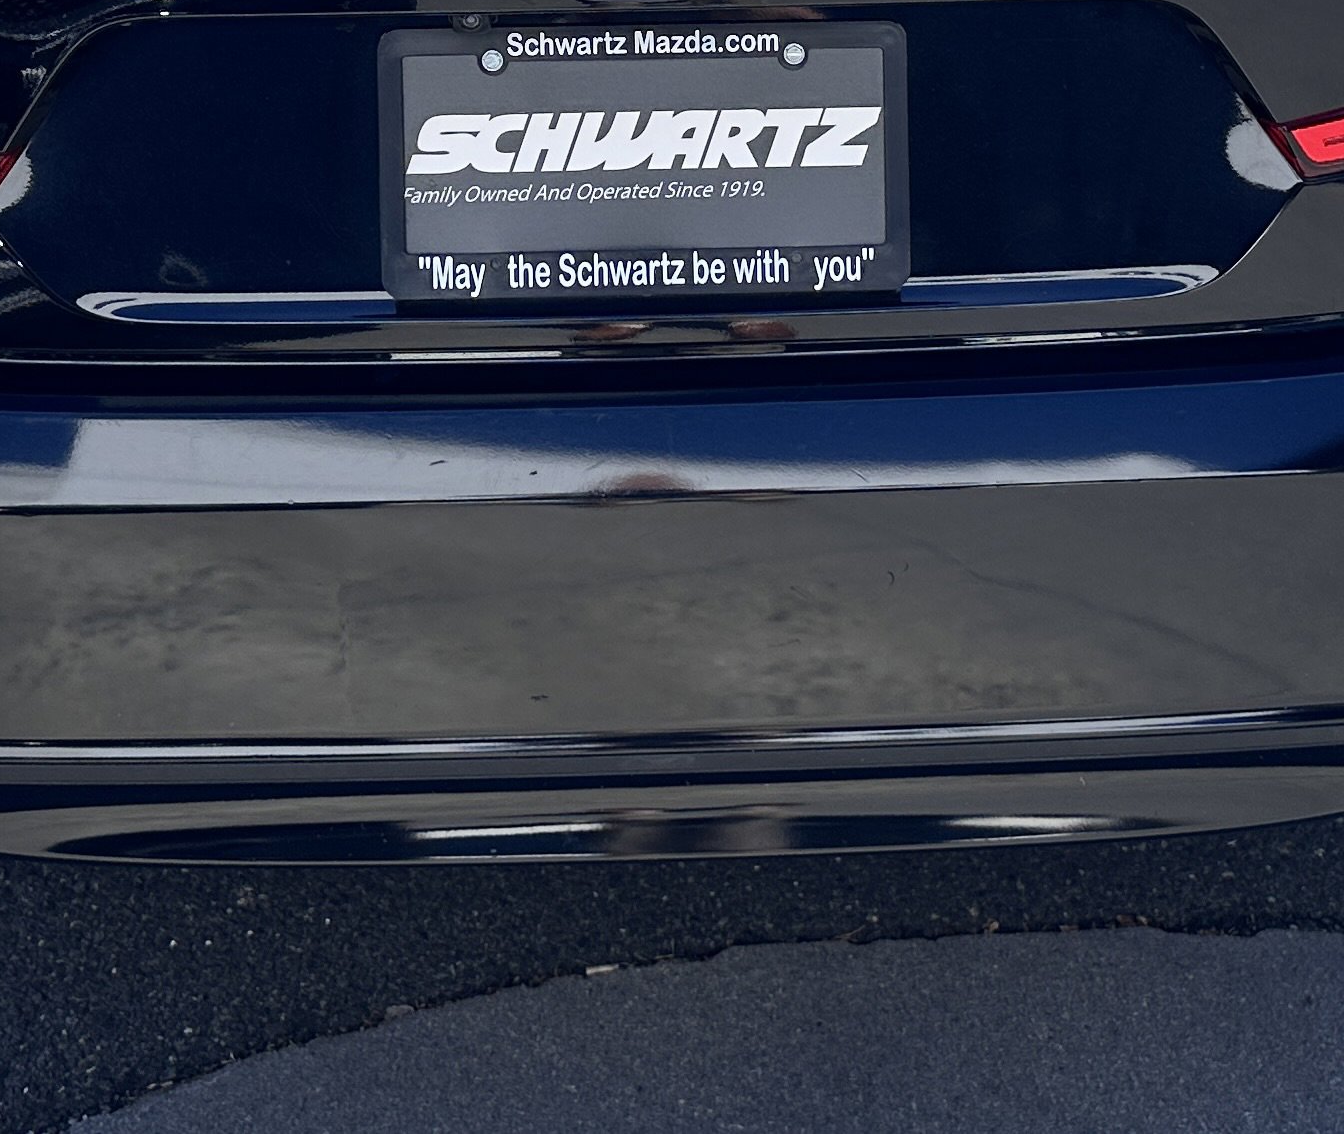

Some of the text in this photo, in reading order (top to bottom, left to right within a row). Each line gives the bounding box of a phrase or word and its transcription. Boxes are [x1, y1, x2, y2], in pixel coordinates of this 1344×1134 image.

[506, 29, 779, 57] Schwartz Mazda.com
[405, 106, 882, 175] SCHWARTZ
[464, 183, 532, 203] Owned
[534, 182, 575, 202] And
[576, 181, 663, 204] Operated
[664, 181, 714, 199] Since
[720, 180, 766, 198] 1919.
[418, 246, 875, 298] "May the Schwartz be with you"
